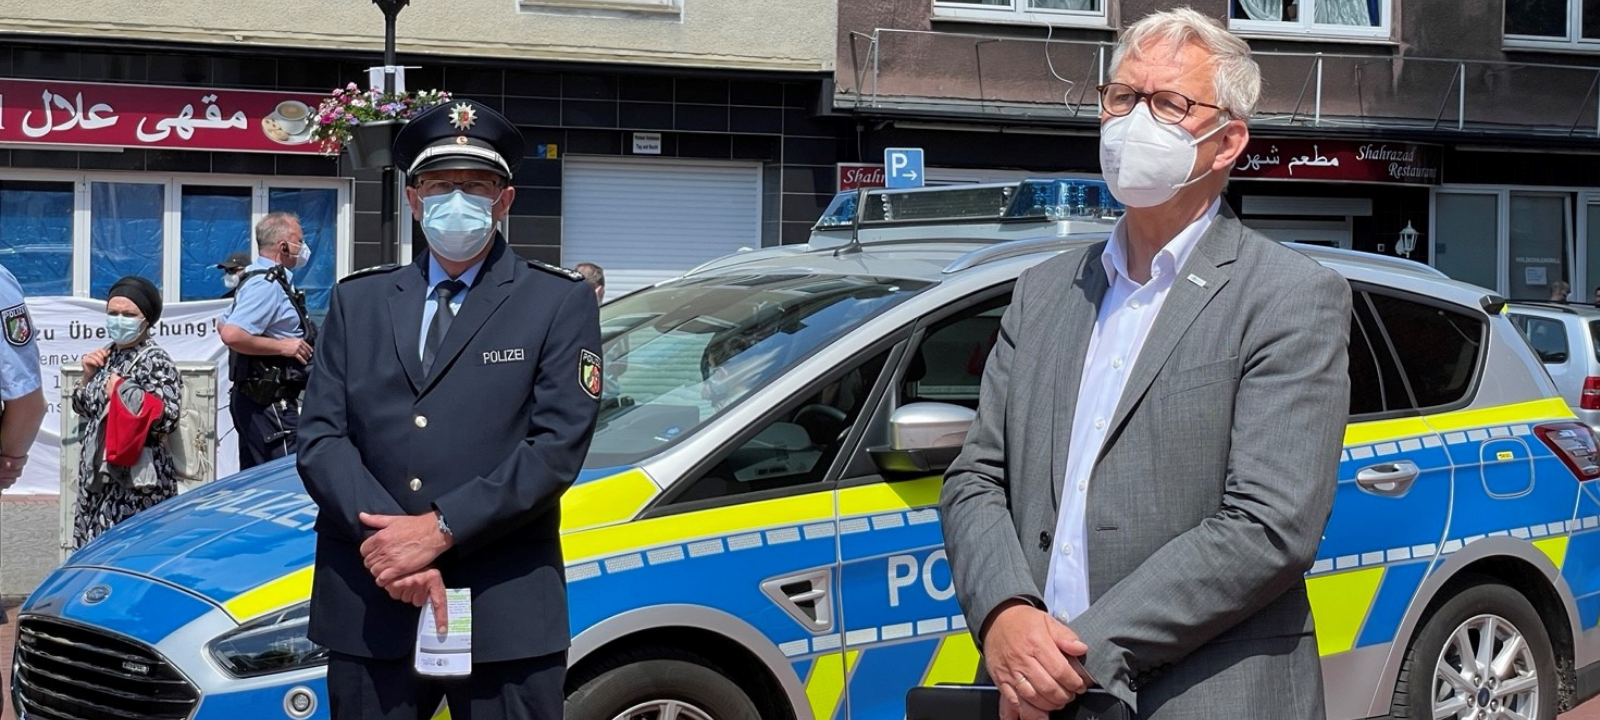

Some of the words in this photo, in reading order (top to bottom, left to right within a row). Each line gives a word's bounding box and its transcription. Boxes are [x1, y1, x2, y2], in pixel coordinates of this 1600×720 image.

[1236, 144, 1280, 171] شهر
[1288, 144, 1339, 176] مطعم
[1355, 144, 1417, 161] Shahrazad
[891, 152, 908, 178] P
[1388, 162, 1438, 179] Restaurant
[3, 305, 26, 318] POLIZE
[483, 349, 525, 364] POLIZEI
[888, 549, 956, 607] PO
